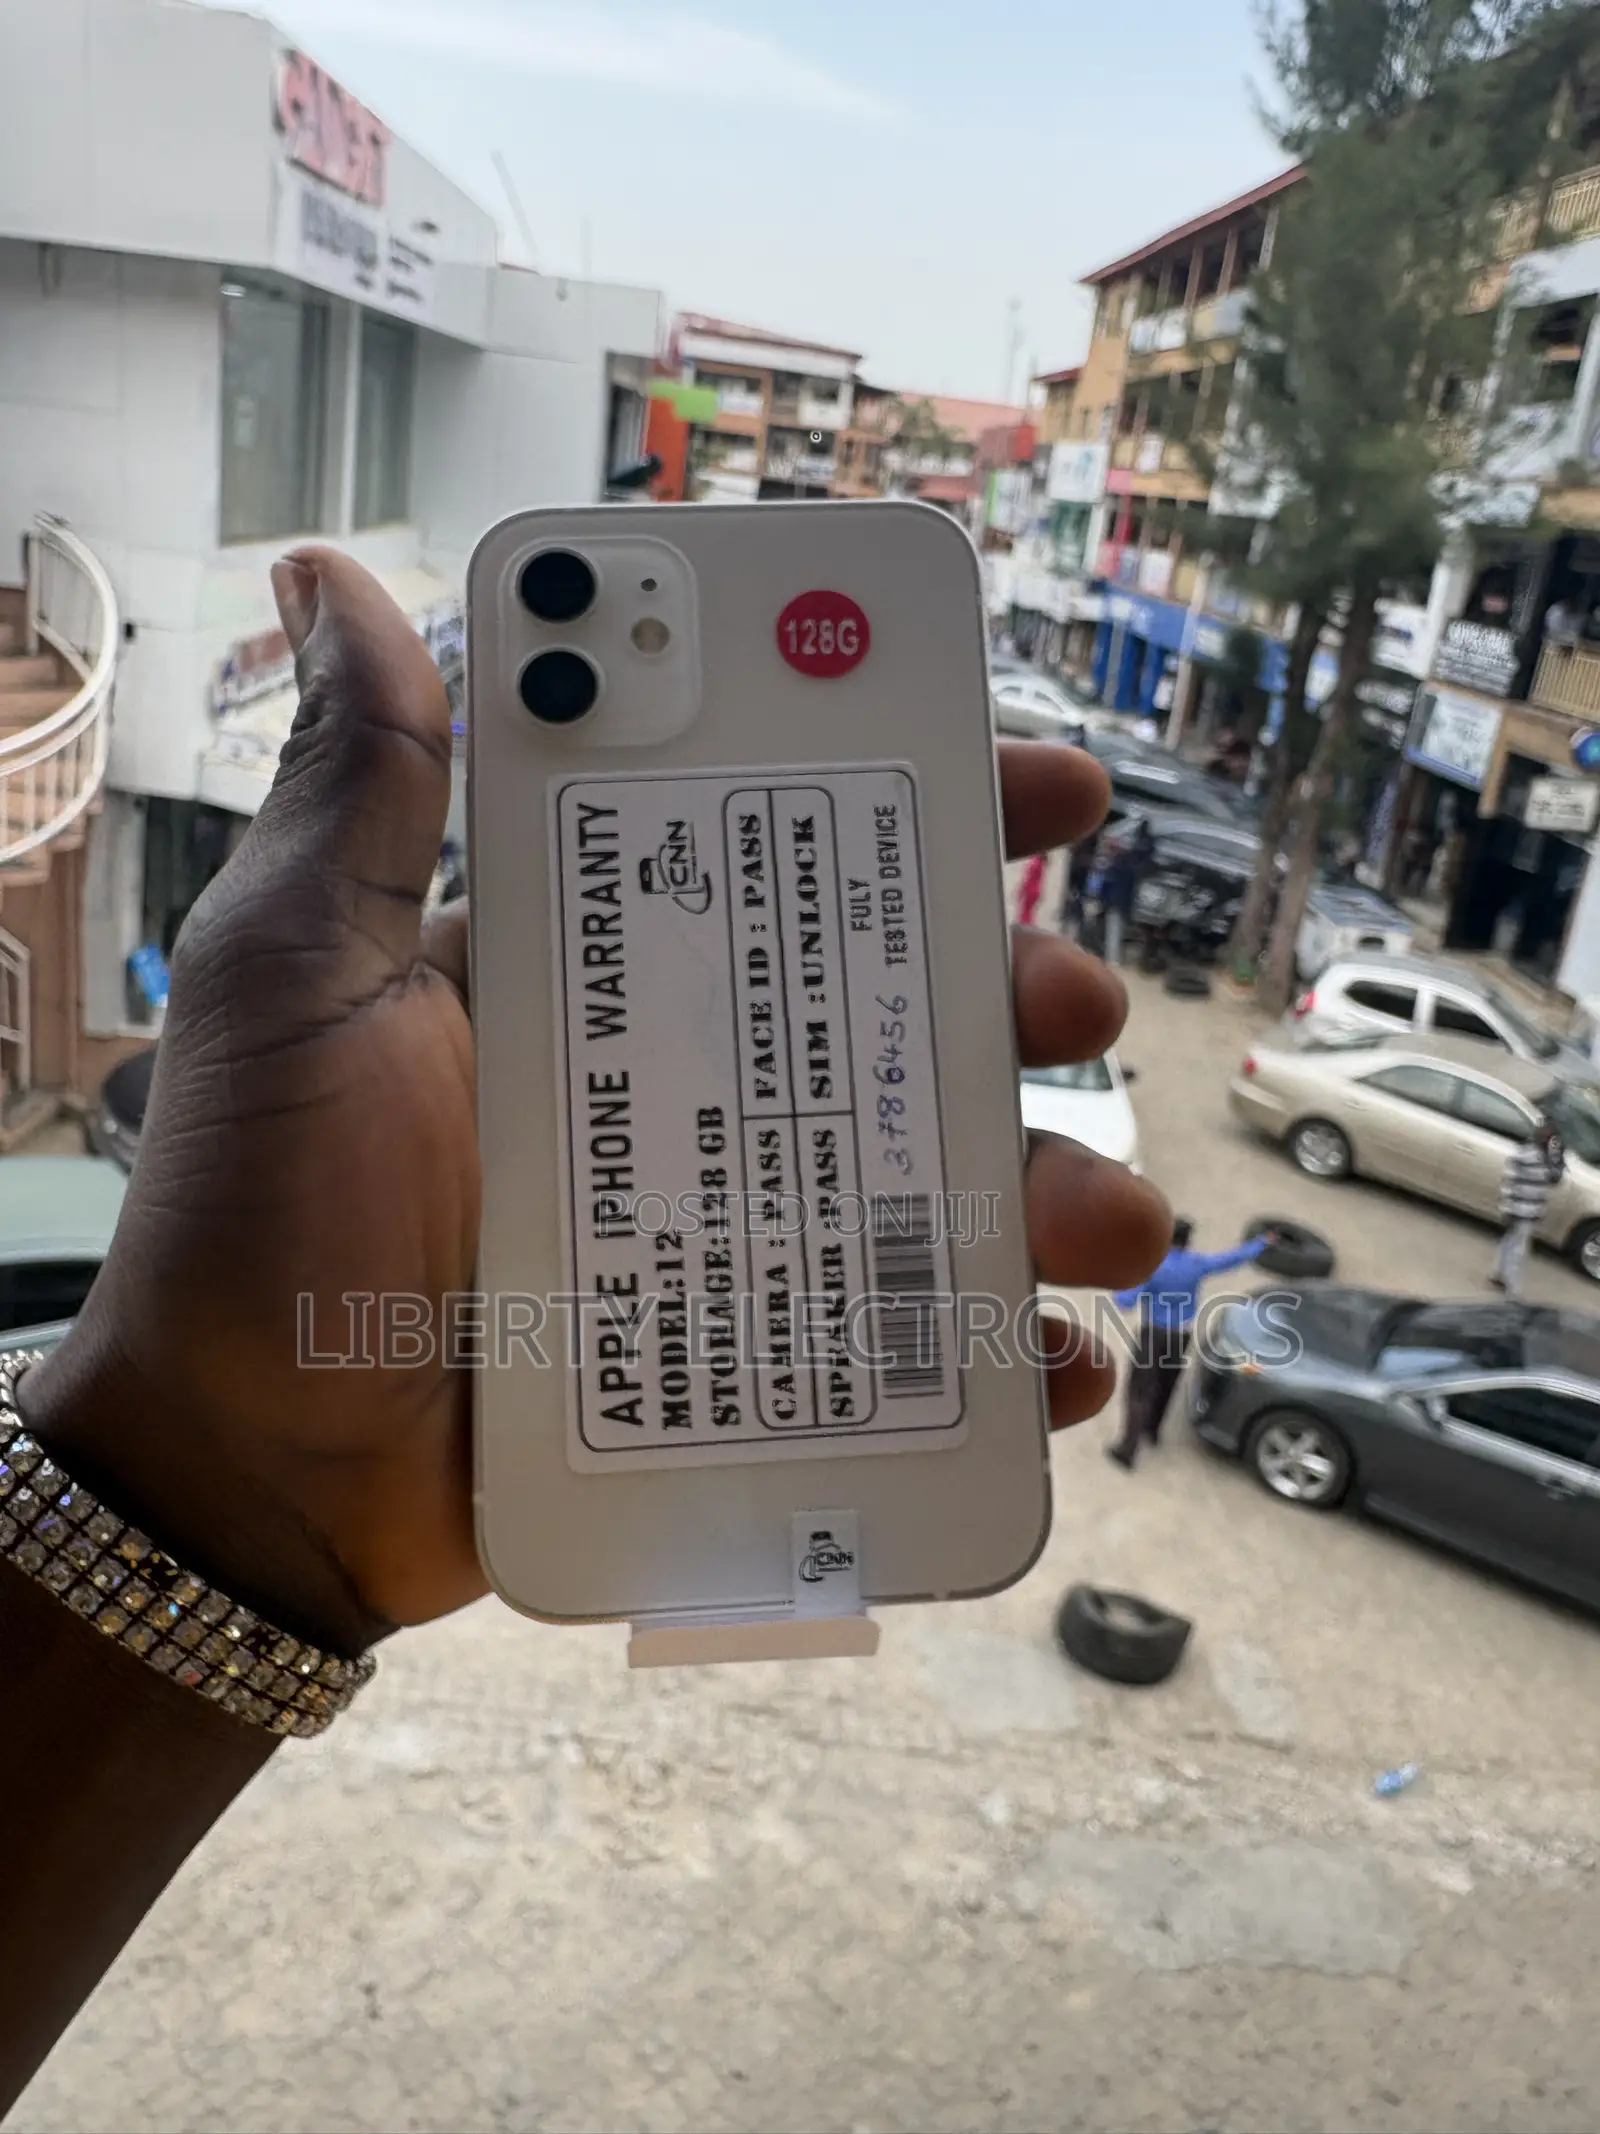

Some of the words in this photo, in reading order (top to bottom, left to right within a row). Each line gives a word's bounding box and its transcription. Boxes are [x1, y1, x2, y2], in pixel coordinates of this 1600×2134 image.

[784, 618, 860, 656] 128G
[666, 819, 688, 888] CNN
[738, 813, 764, 909] PASS
[873, 803, 902, 880] DEVICE
[577, 802, 628, 1041] WARRANTY
[847, 877, 873, 933] FULY
[880, 887, 908, 969] TESTED
[748, 946, 771, 988] ID
[749, 1000, 778, 1100] FACE
[805, 1020, 833, 1100] SIM
[588, 1069, 633, 1239] IPHONE
[697, 1105, 726, 1155] GB
[757, 1128, 783, 1221] PASS
[597, 1272, 643, 1426] APPLE
[766, 1263, 795, 1420] CAMERA
[821, 1242, 855, 1418] SPEAKER
